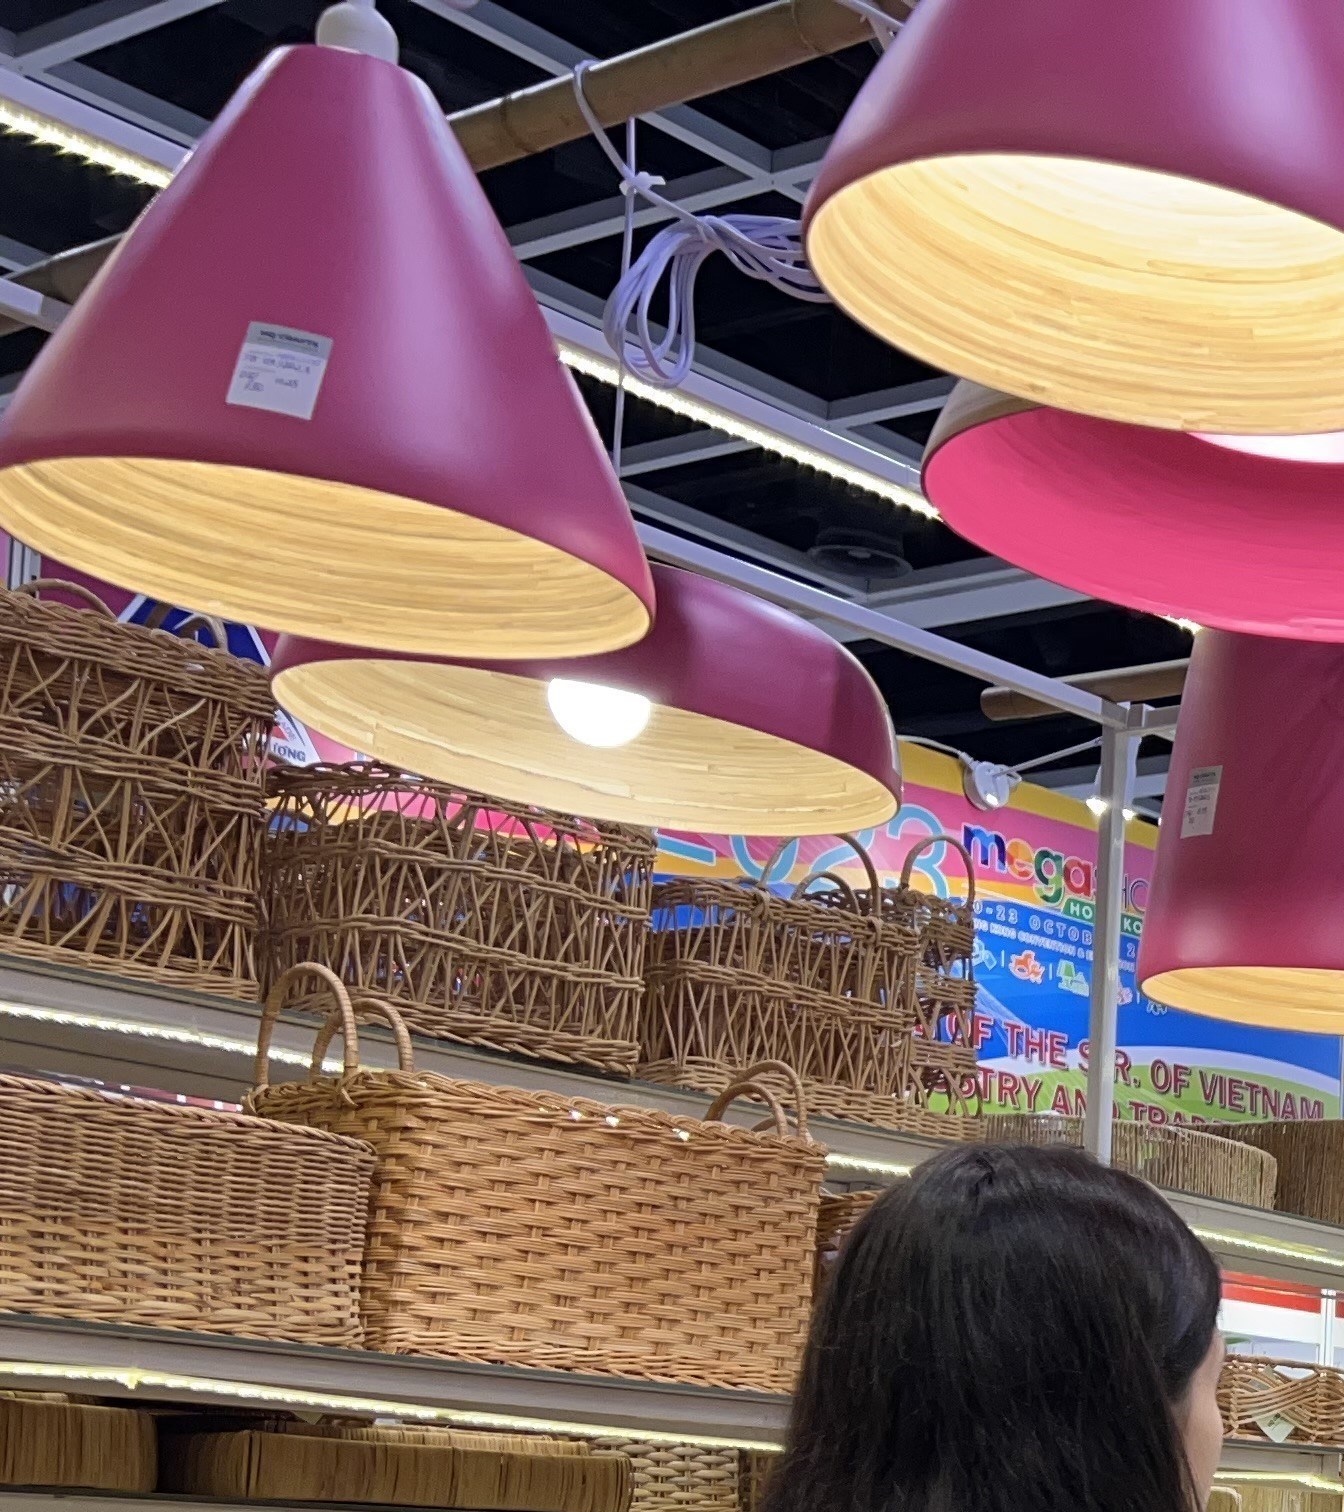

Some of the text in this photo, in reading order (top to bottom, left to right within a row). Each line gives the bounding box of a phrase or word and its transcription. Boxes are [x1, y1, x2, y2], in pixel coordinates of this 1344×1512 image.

[1029, 914, 1093, 945] OCTOB
[1069, 902, 1142, 933] HO KO
[1003, 1020, 1069, 1070] THE
[1150, 1058, 1192, 1098] OF
[1199, 1069, 1324, 1121] VIETNAM
